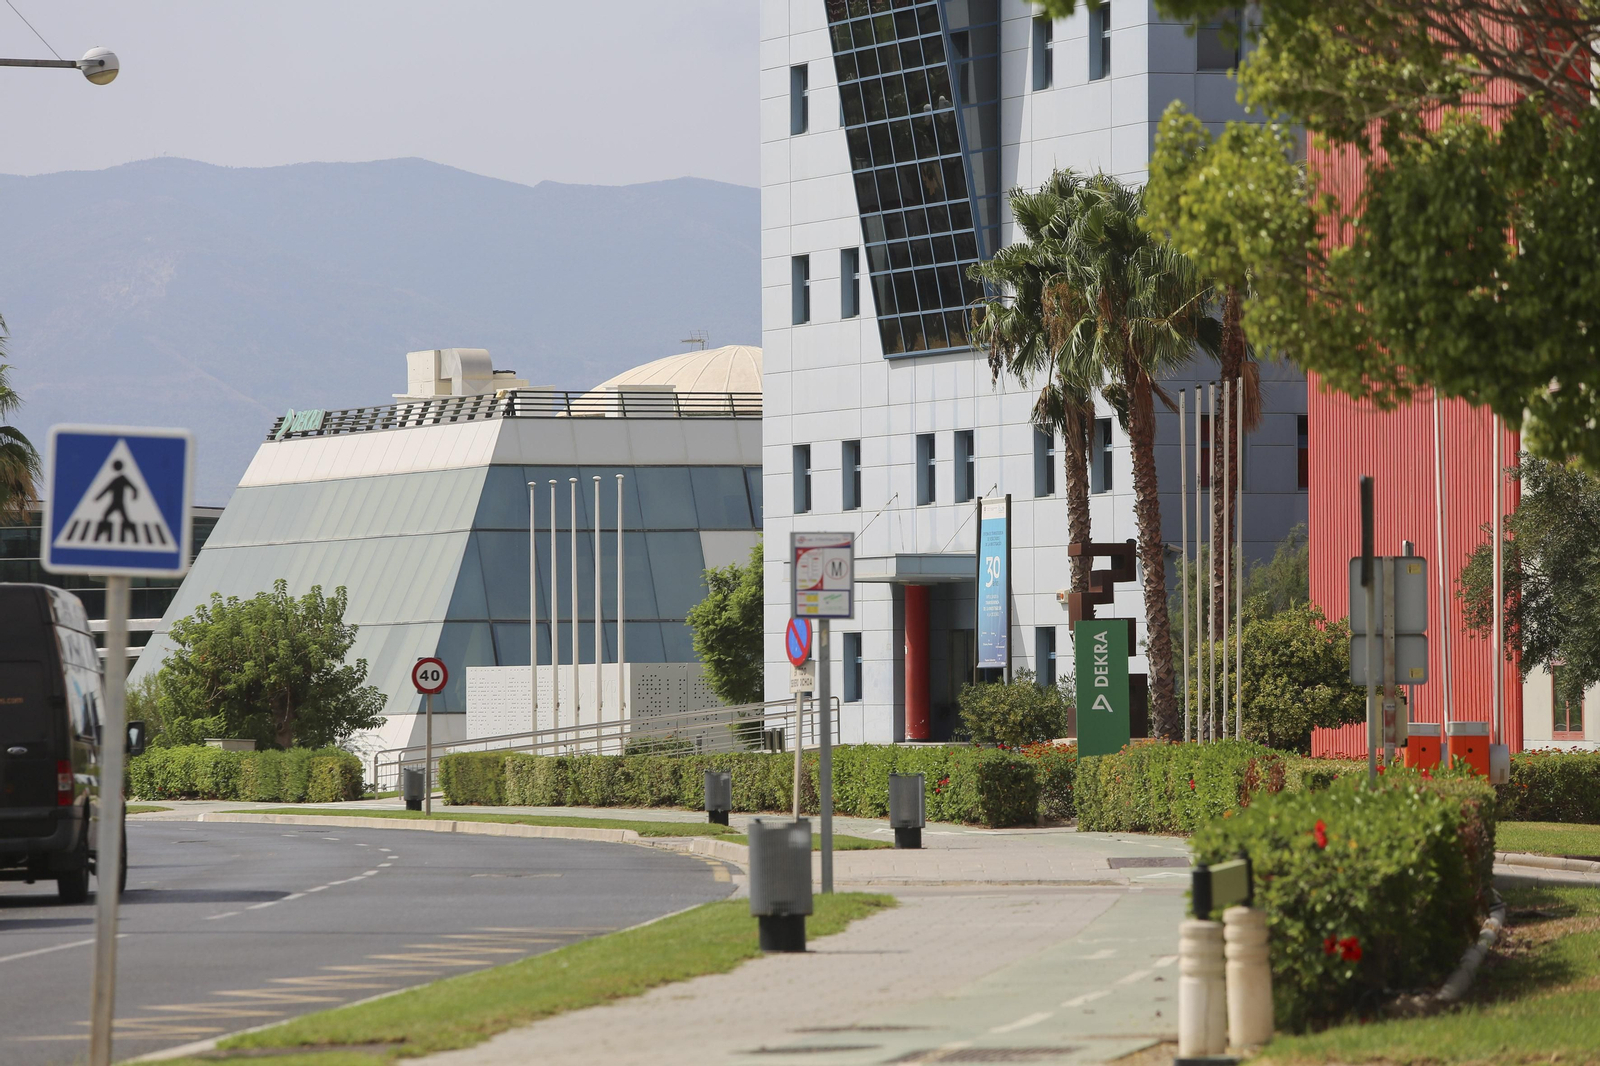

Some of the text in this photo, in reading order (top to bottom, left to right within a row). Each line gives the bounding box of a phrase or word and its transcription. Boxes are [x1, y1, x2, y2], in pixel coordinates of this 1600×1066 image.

[985, 556, 1001, 588] 30
[1093, 630, 1109, 688] DEKRA
[419, 669, 440, 682] 40
